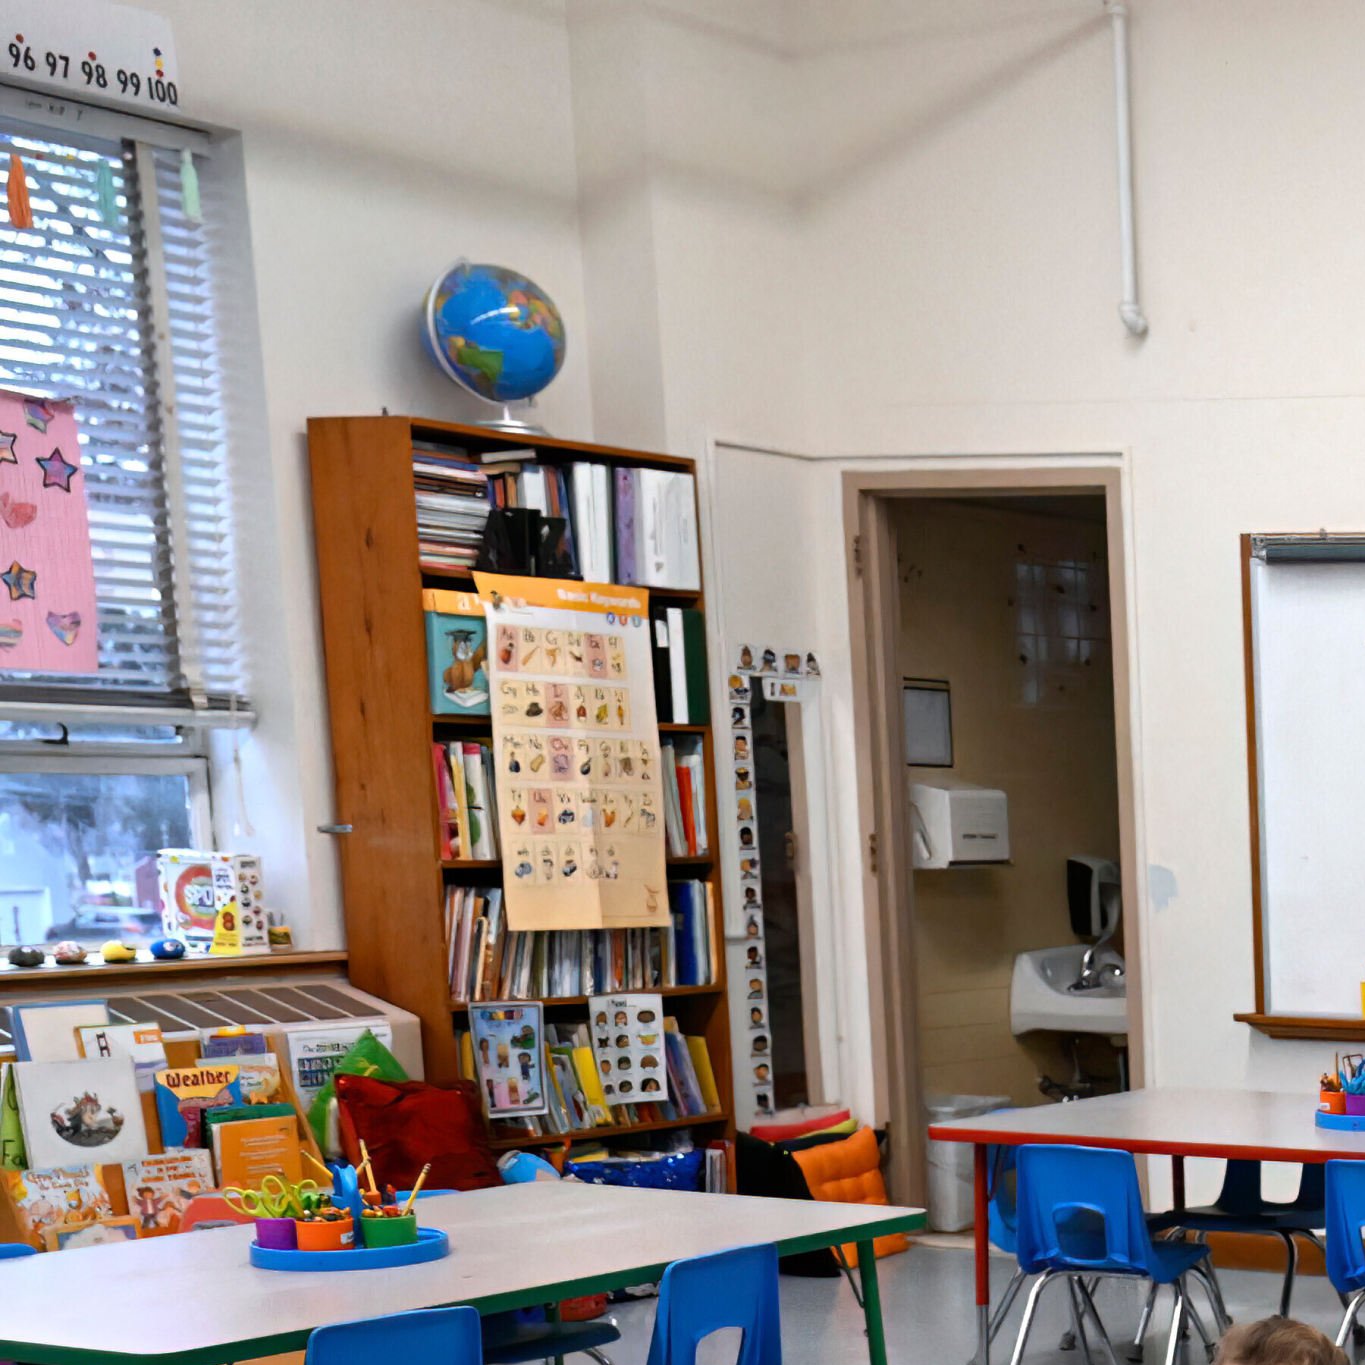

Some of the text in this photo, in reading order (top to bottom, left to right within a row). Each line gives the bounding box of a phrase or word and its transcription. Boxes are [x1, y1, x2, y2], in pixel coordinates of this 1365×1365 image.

[8, 42, 179, 106] 96 97 98 99 100
[165, 1069, 231, 1089] Weather
